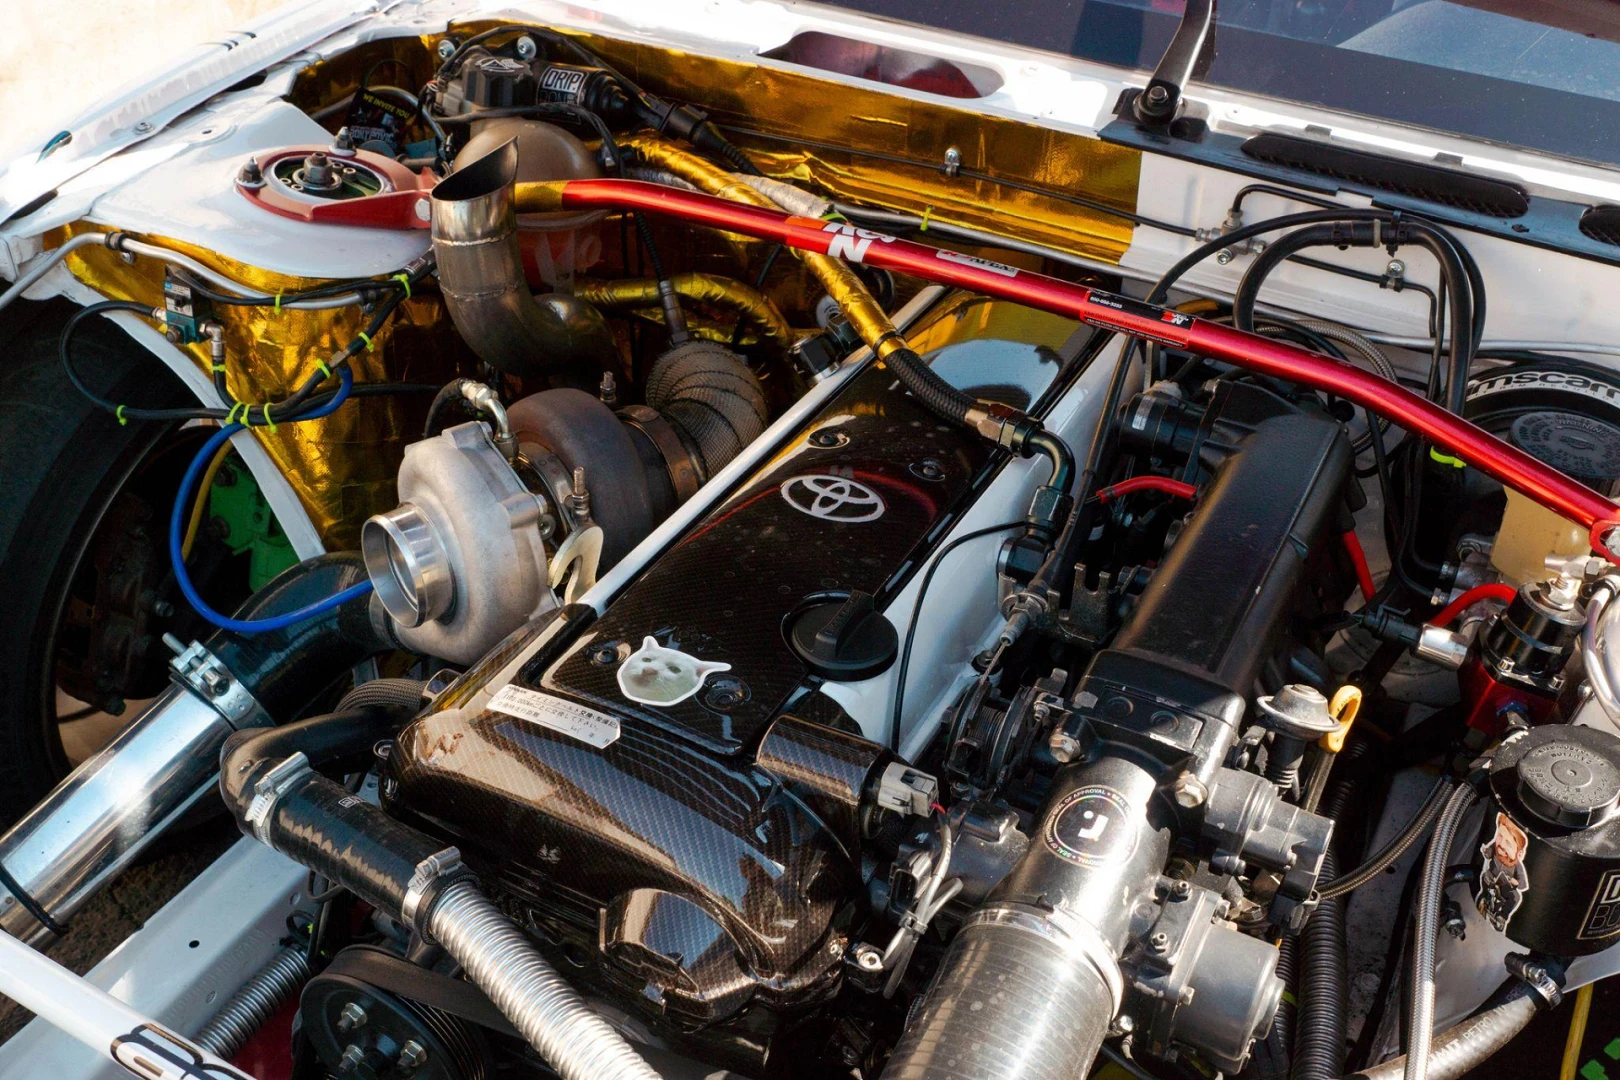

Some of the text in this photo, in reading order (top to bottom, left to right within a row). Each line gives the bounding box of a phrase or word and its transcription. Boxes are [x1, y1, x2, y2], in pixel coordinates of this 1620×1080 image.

[373, 98, 396, 113] INVITE
[396, 108, 410, 119] YOU
[1073, 788, 1106, 799] APPROVAL
[1462, 1015, 1494, 1041] PETRO
